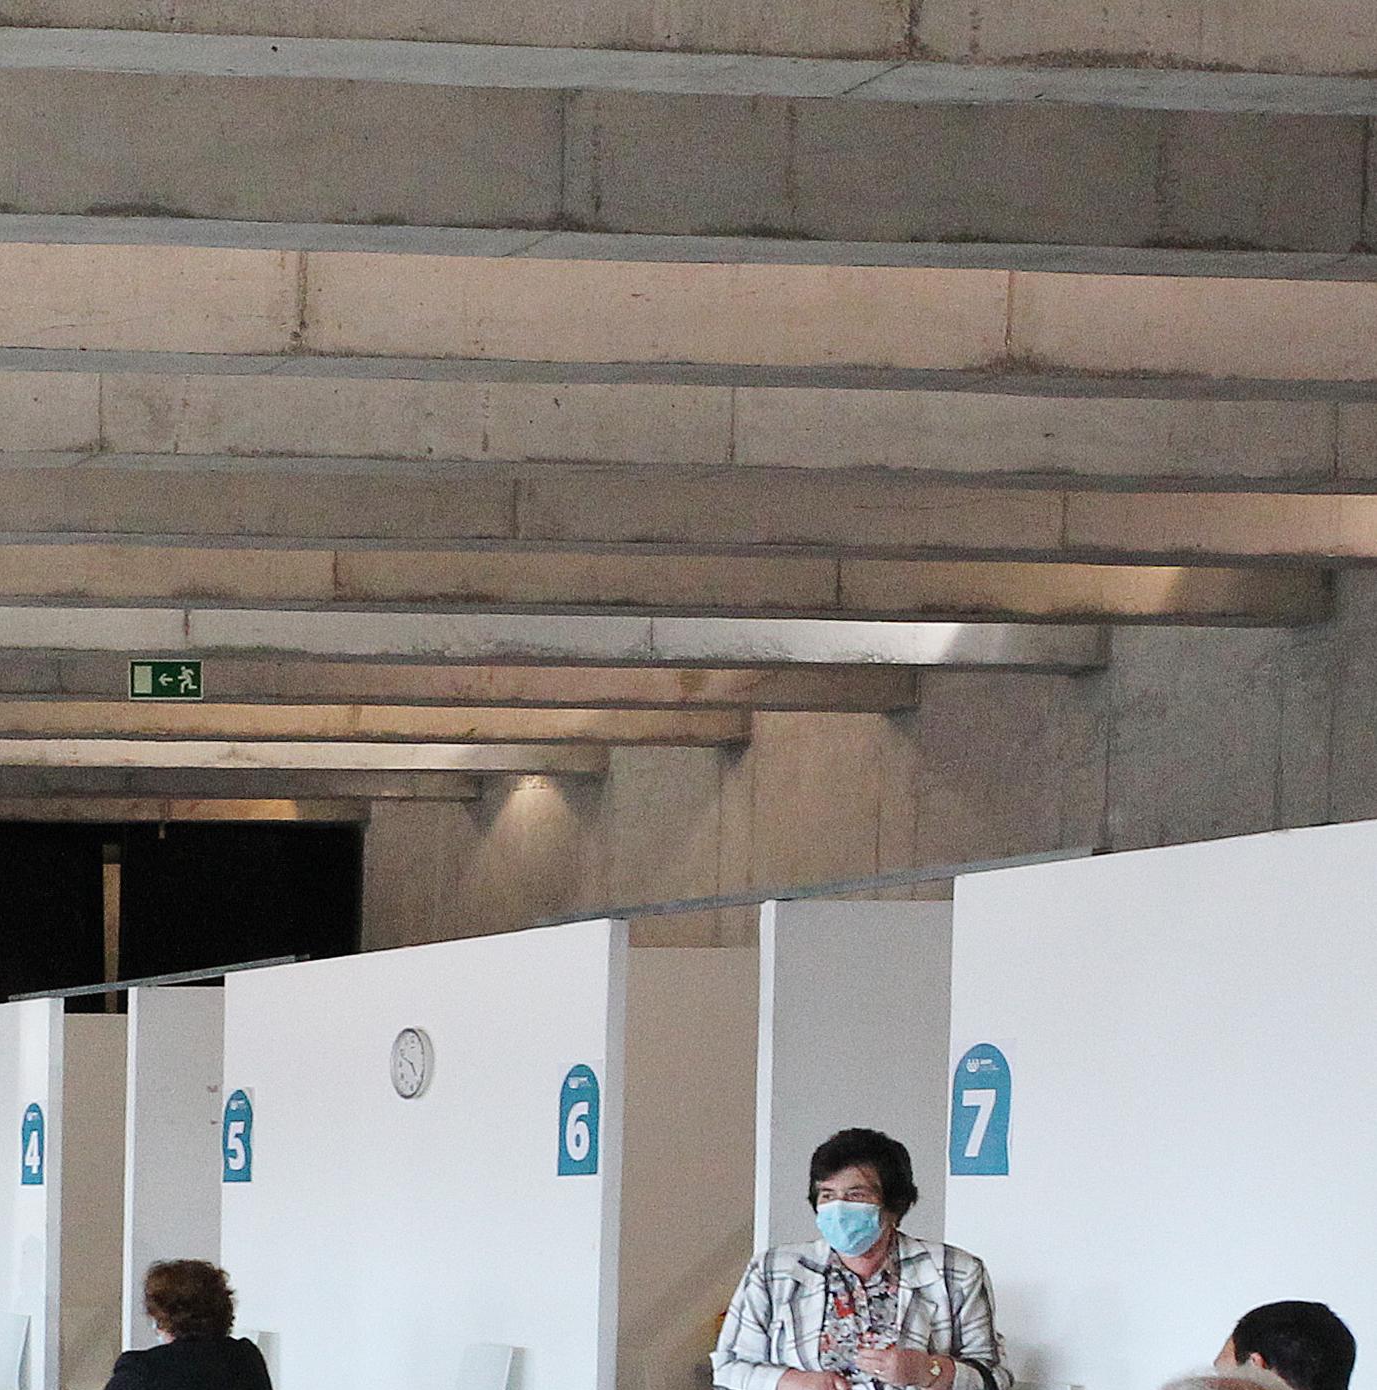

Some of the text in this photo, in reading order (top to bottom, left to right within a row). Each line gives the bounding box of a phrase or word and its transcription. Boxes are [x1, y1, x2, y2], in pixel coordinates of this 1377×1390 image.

[227, 1121, 246, 1171] 5
[566, 1101, 590, 1161] 6
[962, 1089, 996, 1157] 7
[25, 1131, 41, 1174] 4
